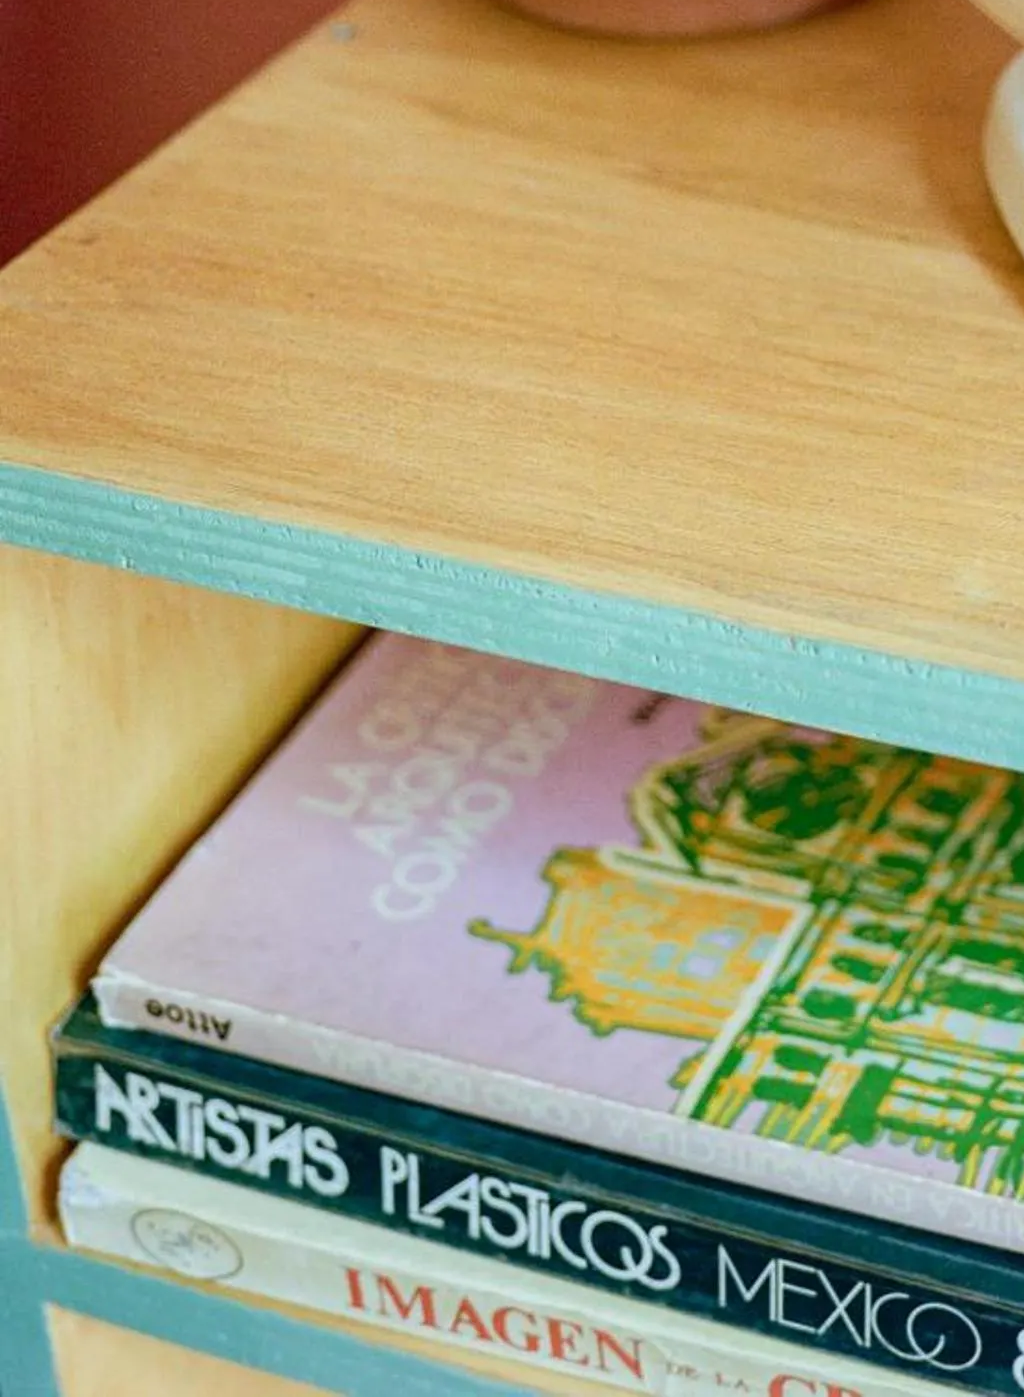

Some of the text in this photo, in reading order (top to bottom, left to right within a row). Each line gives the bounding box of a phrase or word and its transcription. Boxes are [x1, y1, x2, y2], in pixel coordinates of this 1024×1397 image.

[145, 999, 232, 1040] Attoe
[95, 1064, 350, 1199] ARTISTAS
[380, 1145, 683, 1292] PLASTICOS
[717, 1243, 982, 1372] MEXICO
[341, 1266, 648, 1380] IMAGEN
